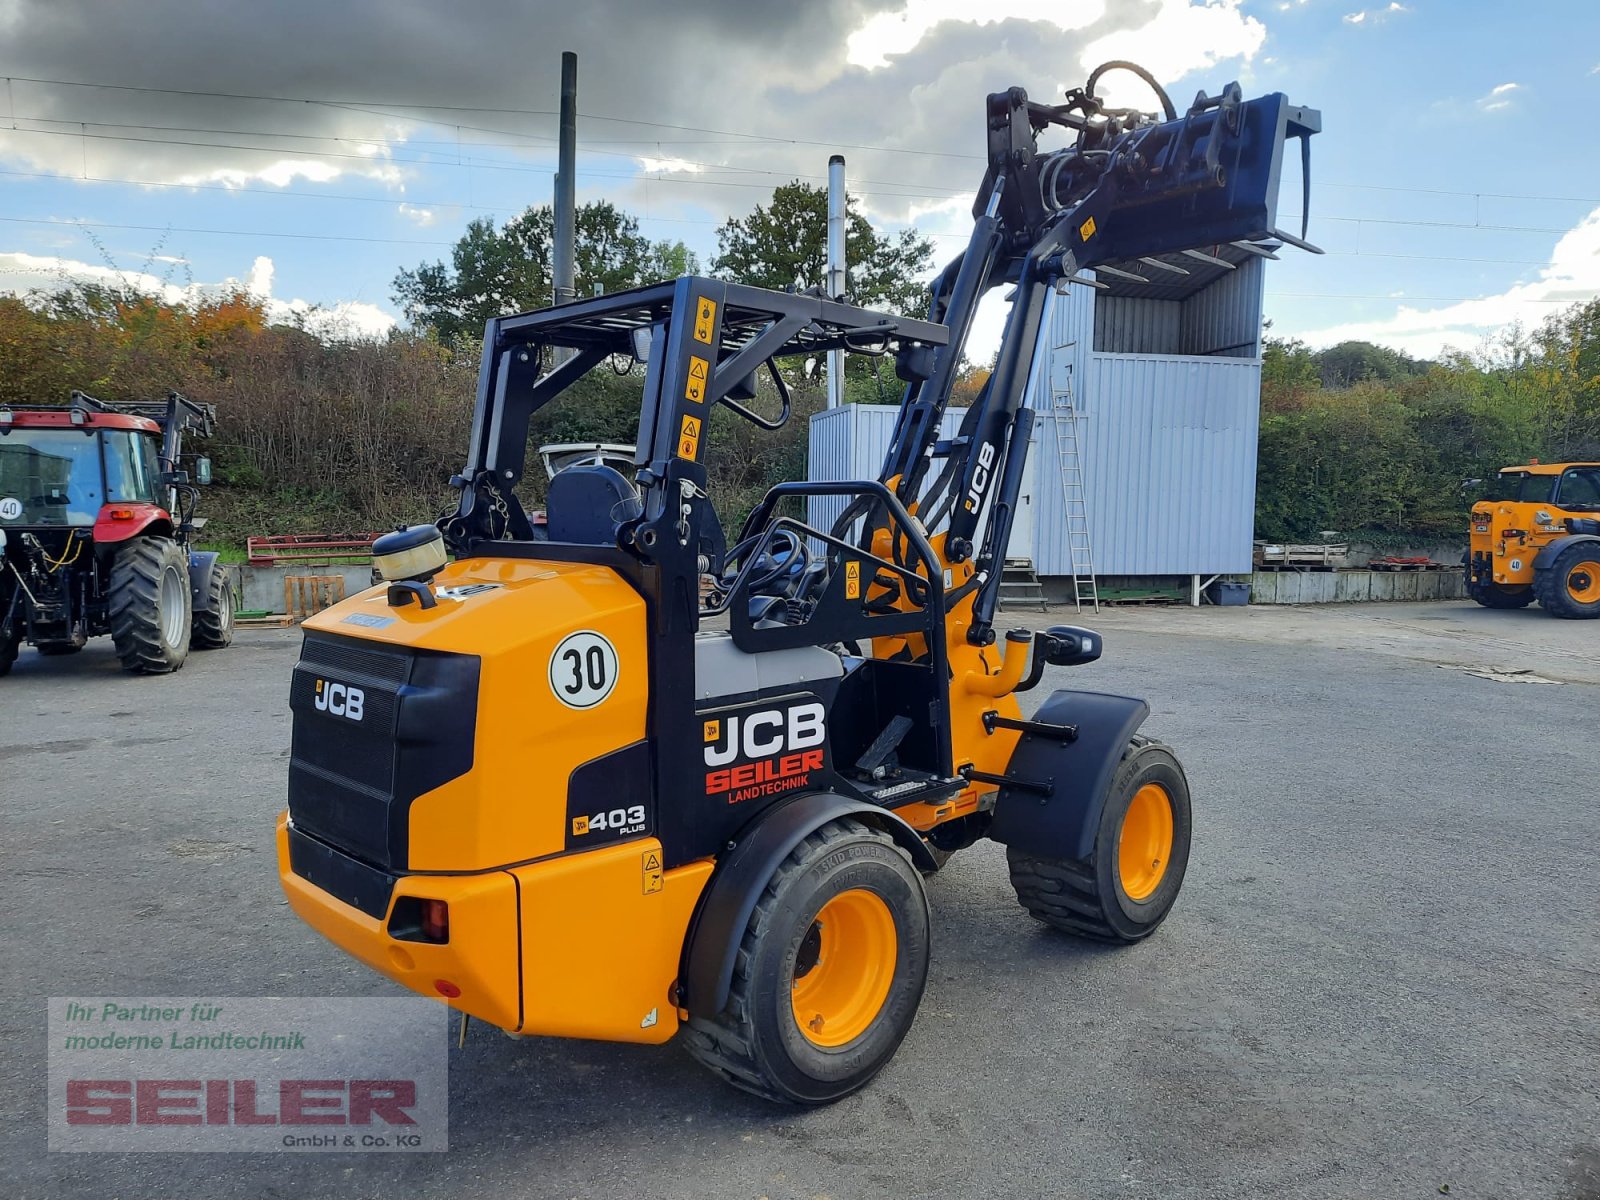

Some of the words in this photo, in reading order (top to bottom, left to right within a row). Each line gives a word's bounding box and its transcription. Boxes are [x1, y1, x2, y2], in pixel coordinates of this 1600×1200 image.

[968, 441, 995, 515] JCB
[2, 502, 16, 515] 40
[1511, 561, 1520, 570] 40
[563, 645, 606, 695] 30
[315, 681, 364, 721] JCB
[704, 702, 825, 767] JCB
[706, 749, 824, 795] SEILER
[728, 774, 809, 804] LANDTECHNIK
[589, 805, 645, 830] 403
[620, 823, 646, 835] PLUS
[821, 852, 845, 873] SKID
